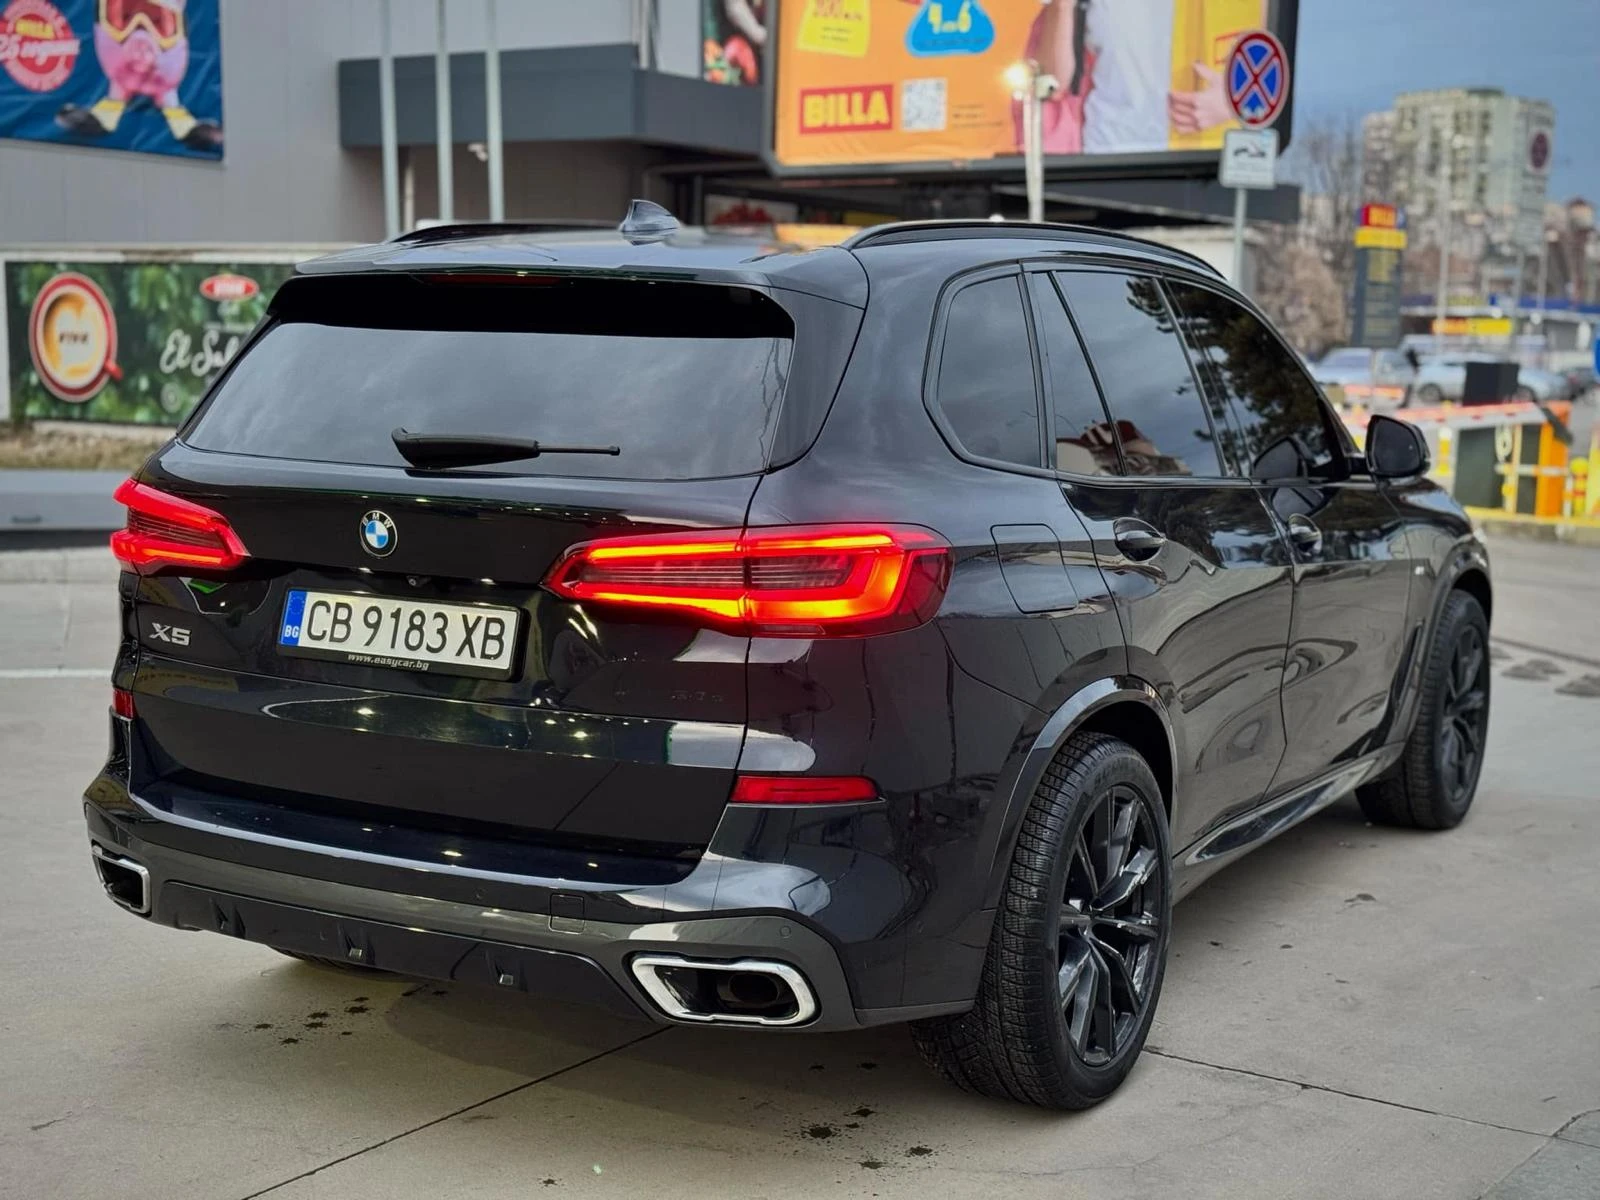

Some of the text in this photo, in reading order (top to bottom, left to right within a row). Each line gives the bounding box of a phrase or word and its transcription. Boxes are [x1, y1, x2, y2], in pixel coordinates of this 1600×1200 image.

[803, 90, 890, 128] BILLA
[160, 328, 192, 374] El
[149, 622, 191, 646] X5
[284, 624, 299, 639] BG
[307, 600, 506, 661] CB 9183 XB
[347, 652, 430, 671] www.easycar.bg
